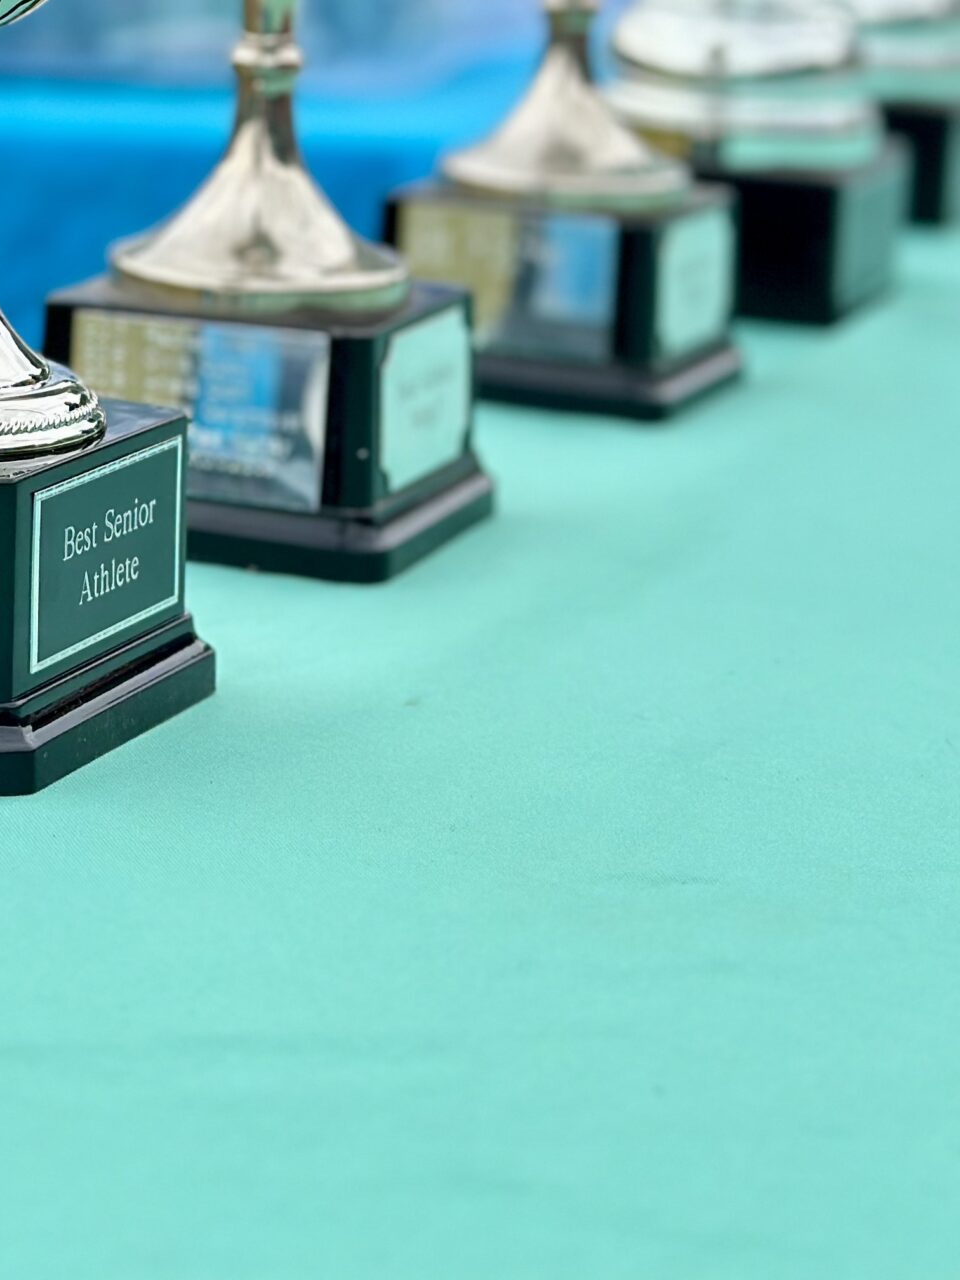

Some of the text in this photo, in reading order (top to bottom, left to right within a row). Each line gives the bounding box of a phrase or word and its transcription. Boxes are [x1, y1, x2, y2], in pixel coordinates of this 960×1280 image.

[63, 498, 156, 561] Best Senior
[79, 556, 140, 605] Athlete
